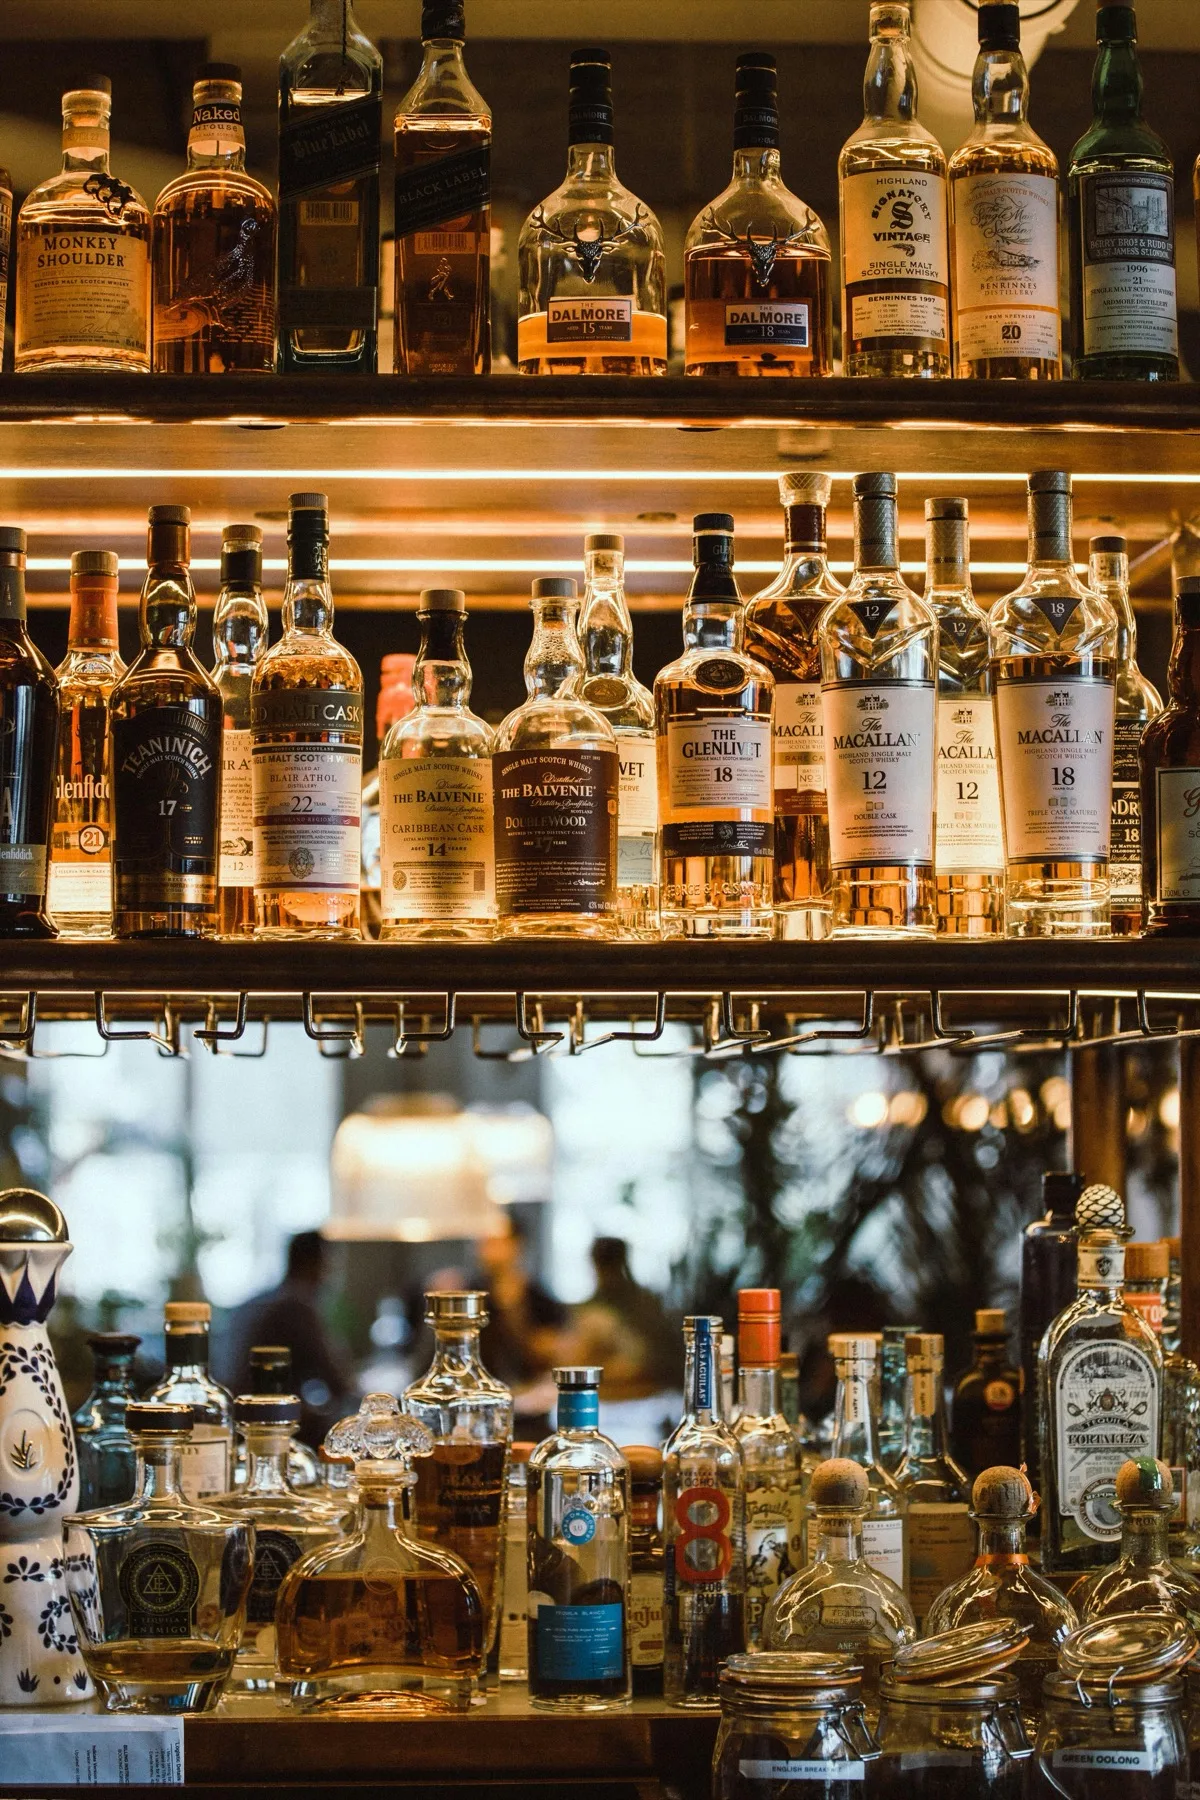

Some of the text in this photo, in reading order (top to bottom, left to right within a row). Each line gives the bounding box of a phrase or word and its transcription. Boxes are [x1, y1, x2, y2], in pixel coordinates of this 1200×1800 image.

[193, 106, 241, 124] Naked
[330, 119, 371, 150] Label
[400, 167, 487, 205] BLACK LABEL
[876, 178, 928, 186] HIGHLAND
[871, 189, 932, 221] SIGNATORY
[890, 201, 914, 229] S
[44, 236, 118, 251] MONKEY
[873, 232, 931, 243] VINTAGE
[1090, 239, 1166, 249] BERRY RUDD
[37, 253, 125, 268] SHOULDER
[869, 261, 933, 270] SINGLE MALT
[861, 268, 939, 278] SCOTCH WHISKY
[1126, 264, 1148, 273] 1996
[980, 282, 1037, 290] BENRINNES
[1132, 276, 1142, 285] 21
[1137, 299, 1168, 307] DISTILLERY
[552, 308, 626, 321] DALMORE
[730, 312, 802, 324] DALMORE
[582, 322, 595, 334] 15
[761, 325, 775, 337] 18
[1001, 324, 1022, 340] 20
[865, 605, 880, 617] 12
[1050, 602, 1065, 615] 18
[952, 622, 967, 633] 12
[322, 704, 360, 723] CASK
[798, 711, 817, 725] The
[1048, 713, 1071, 728] The
[859, 717, 882, 732] The
[711, 729, 736, 740] THE
[833, 733, 918, 750] MACALLAN
[953, 730, 974, 745] The
[1017, 729, 1103, 745] MACALLAN
[121, 736, 212, 776] TEANINICH
[682, 742, 761, 758] GLENLIVET
[838, 752, 869, 760] HIGHLAND
[268, 754, 293, 764] MALT
[136, 754, 199, 779] SINGLE MALT SCOTCH WHISKY
[393, 763, 484, 782] SINGLE MALT SCOTCH WHISKY
[501, 756, 593, 777] SINGLE MALT SCOTCH WHISKY
[270, 774, 337, 782] BLAIR ATHOL
[541, 771, 575, 784] Distilled
[713, 766, 733, 783] 18
[862, 770, 887, 790] 12
[1051, 766, 1076, 786] 18
[435, 778, 467, 790] Distilled
[956, 781, 979, 800] 12
[393, 790, 485, 803] THE BALVENIE
[501, 784, 594, 799] THE BALVENIE
[159, 800, 177, 816] 17
[290, 795, 313, 813] 22
[392, 823, 485, 834] CARIBBEAN CASK
[1124, 828, 1139, 842] 18
[83, 831, 101, 847] 21
[536, 836, 553, 852] 17
[427, 843, 448, 857] 14
[233, 861, 244, 871] 12
[1081, 1416, 1133, 1429] TEQUILA
[1068, 1433, 1147, 1447] FORTALEZA
[684, 1478, 714, 1487] OCHO
[675, 1487, 733, 1584] 8
[134, 1626, 187, 1634] ENEMIGO
[1062, 1753, 1140, 1766] GREEN OOLONG
